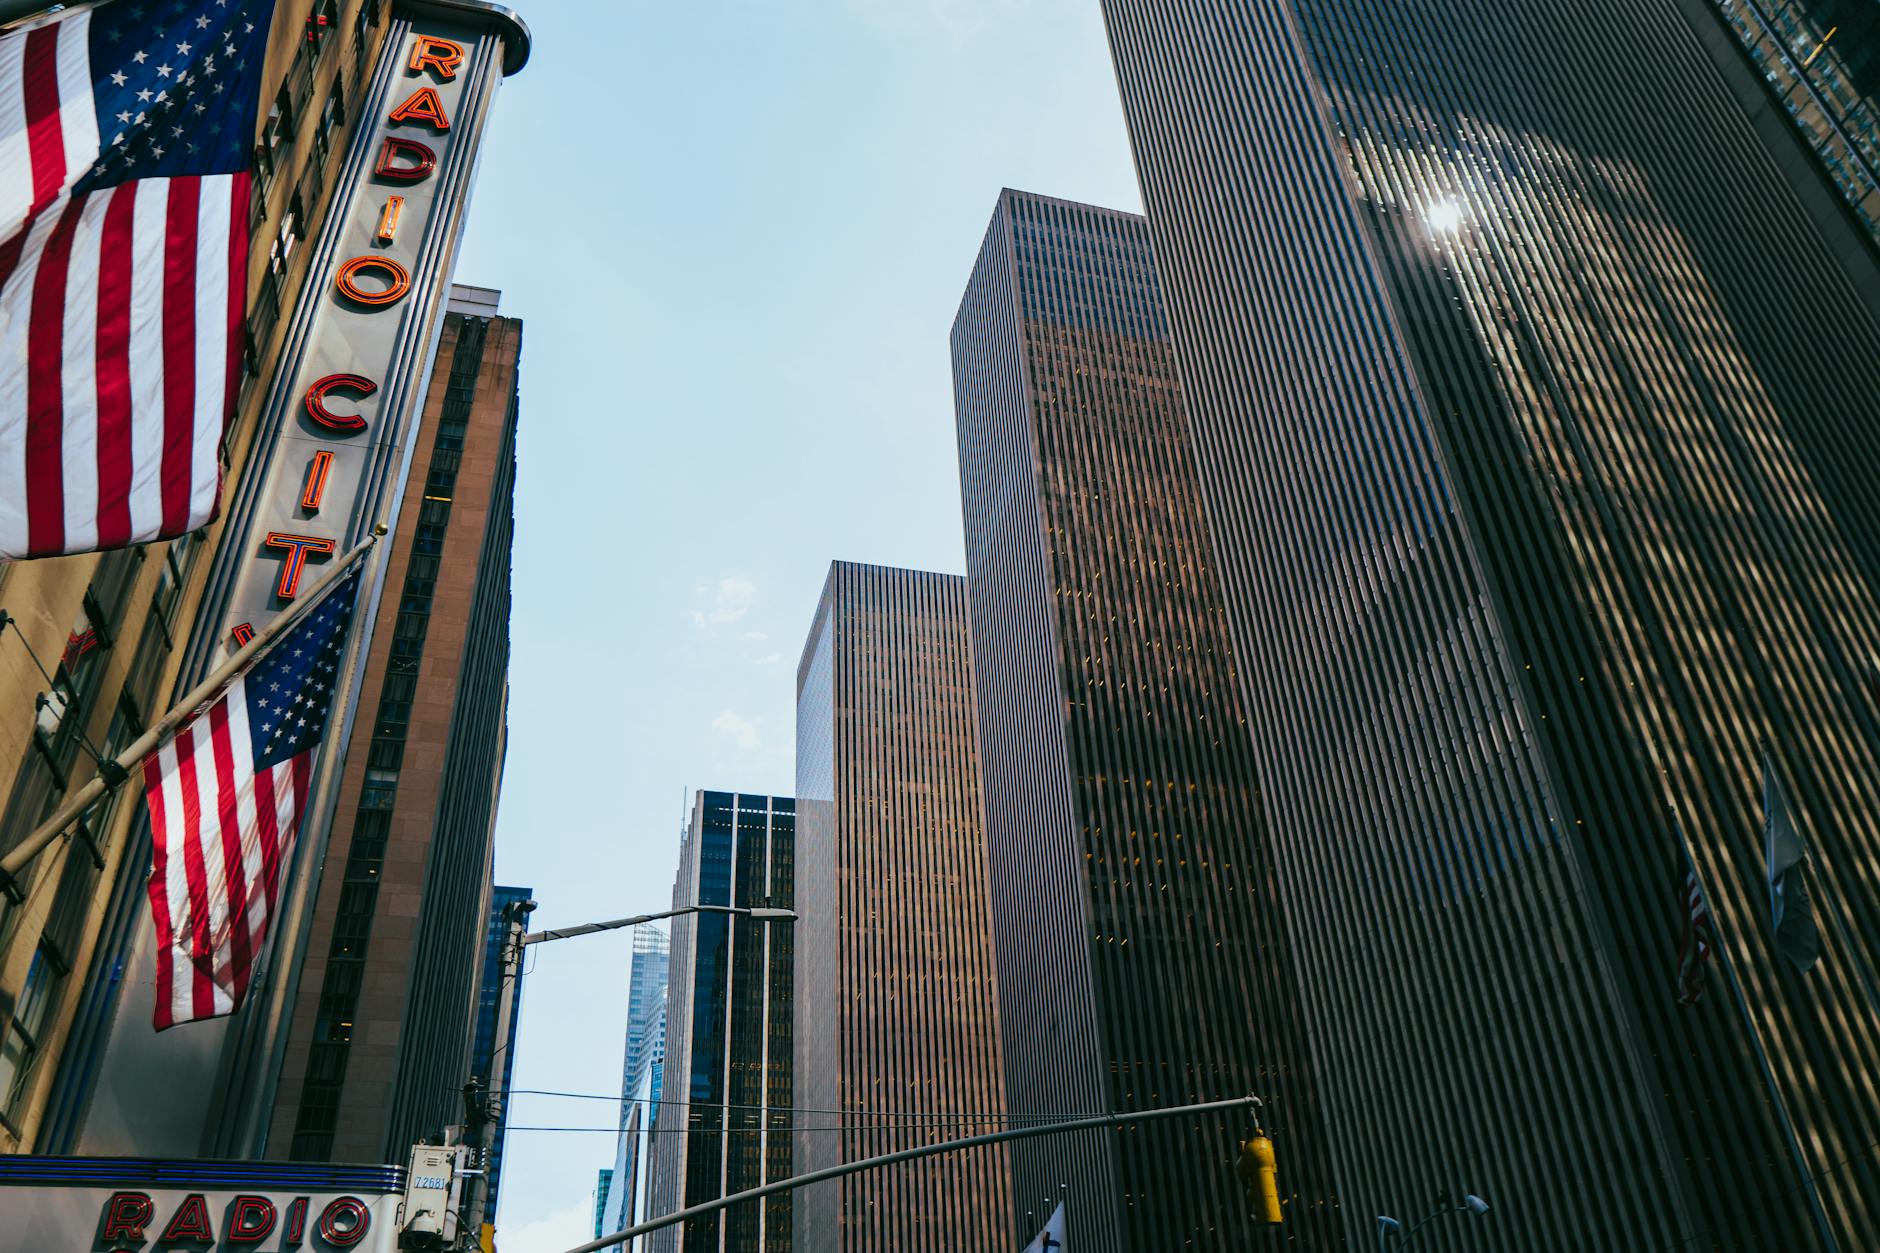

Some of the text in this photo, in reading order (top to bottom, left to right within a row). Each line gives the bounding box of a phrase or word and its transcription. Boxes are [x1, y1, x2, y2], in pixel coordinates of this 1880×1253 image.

[335, 34, 466, 305] RADIO
[415, 1176, 445, 1190] 72681
[102, 1191, 372, 1246] RADIO
